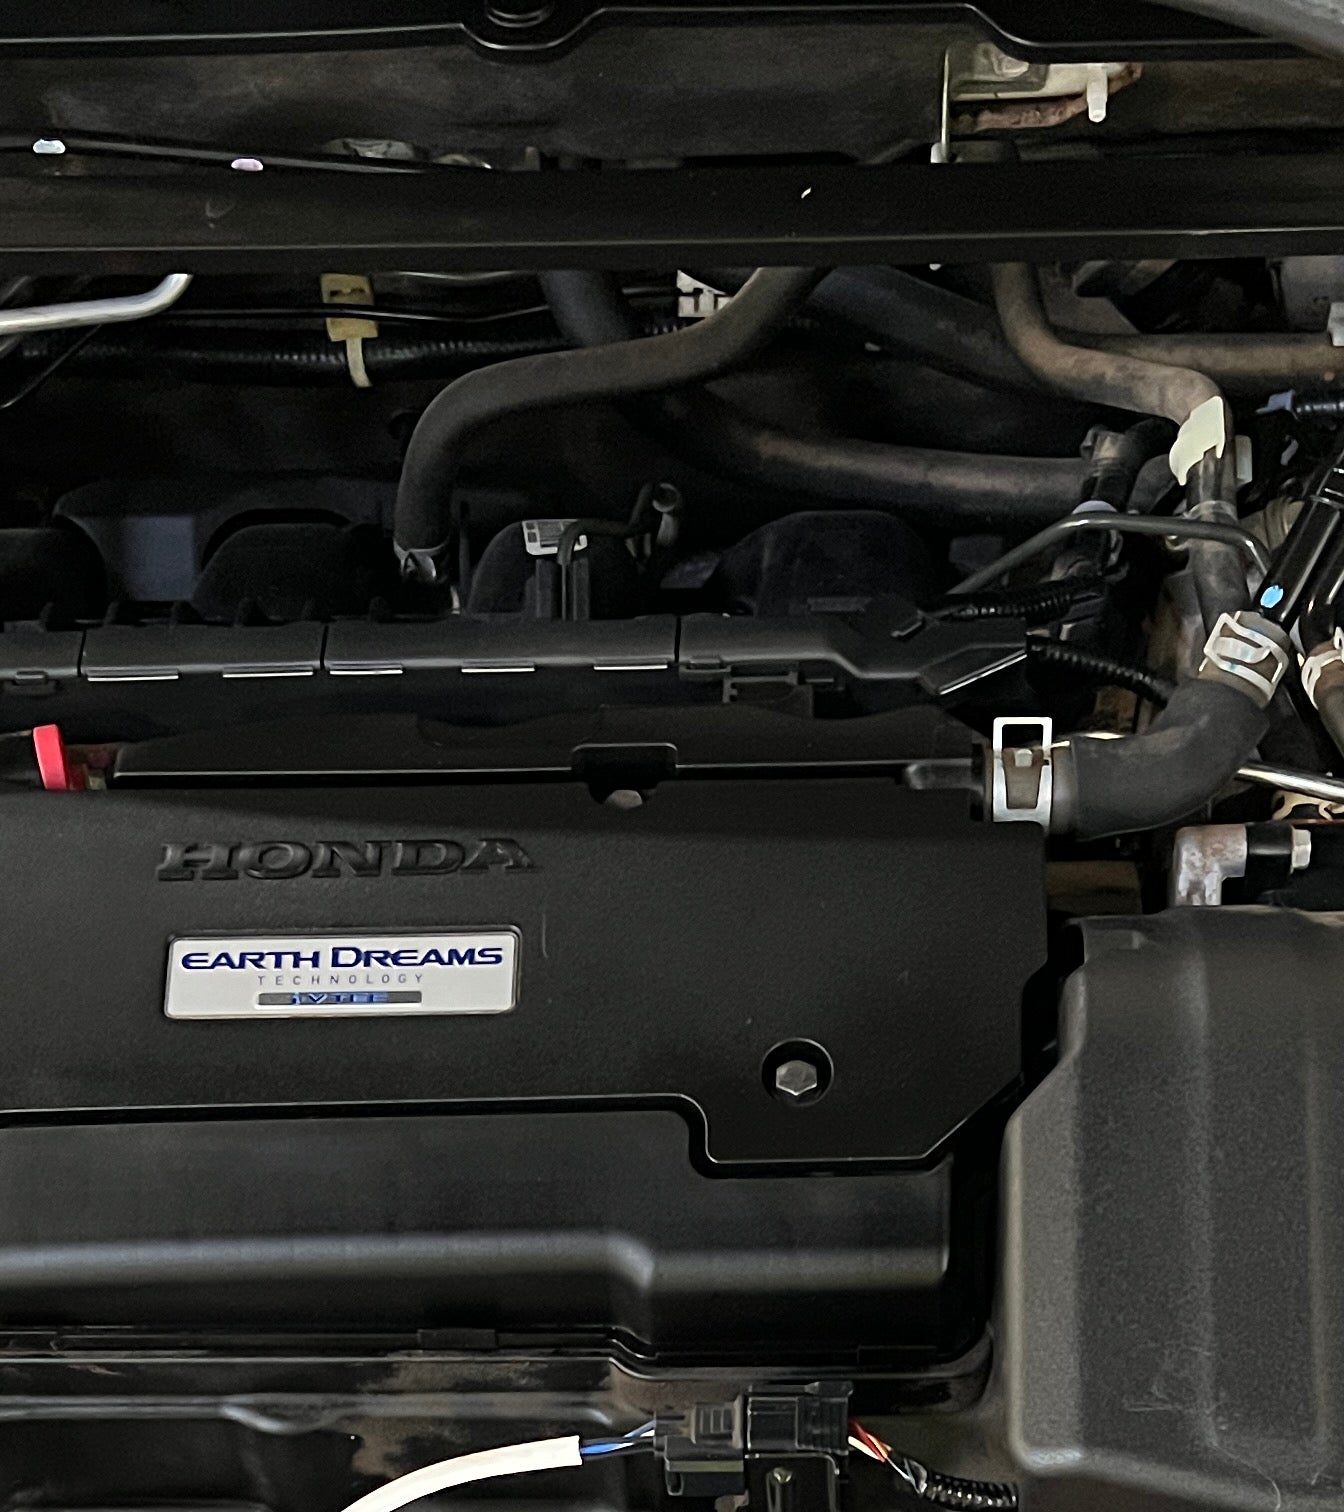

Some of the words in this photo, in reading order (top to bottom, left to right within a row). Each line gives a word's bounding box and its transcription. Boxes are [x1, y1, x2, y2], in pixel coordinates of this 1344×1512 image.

[156, 837, 539, 883] HONDA
[181, 949, 320, 973] EARTH
[330, 946, 503, 970] DREAMS
[257, 974, 425, 986] TECHNOLOGY
